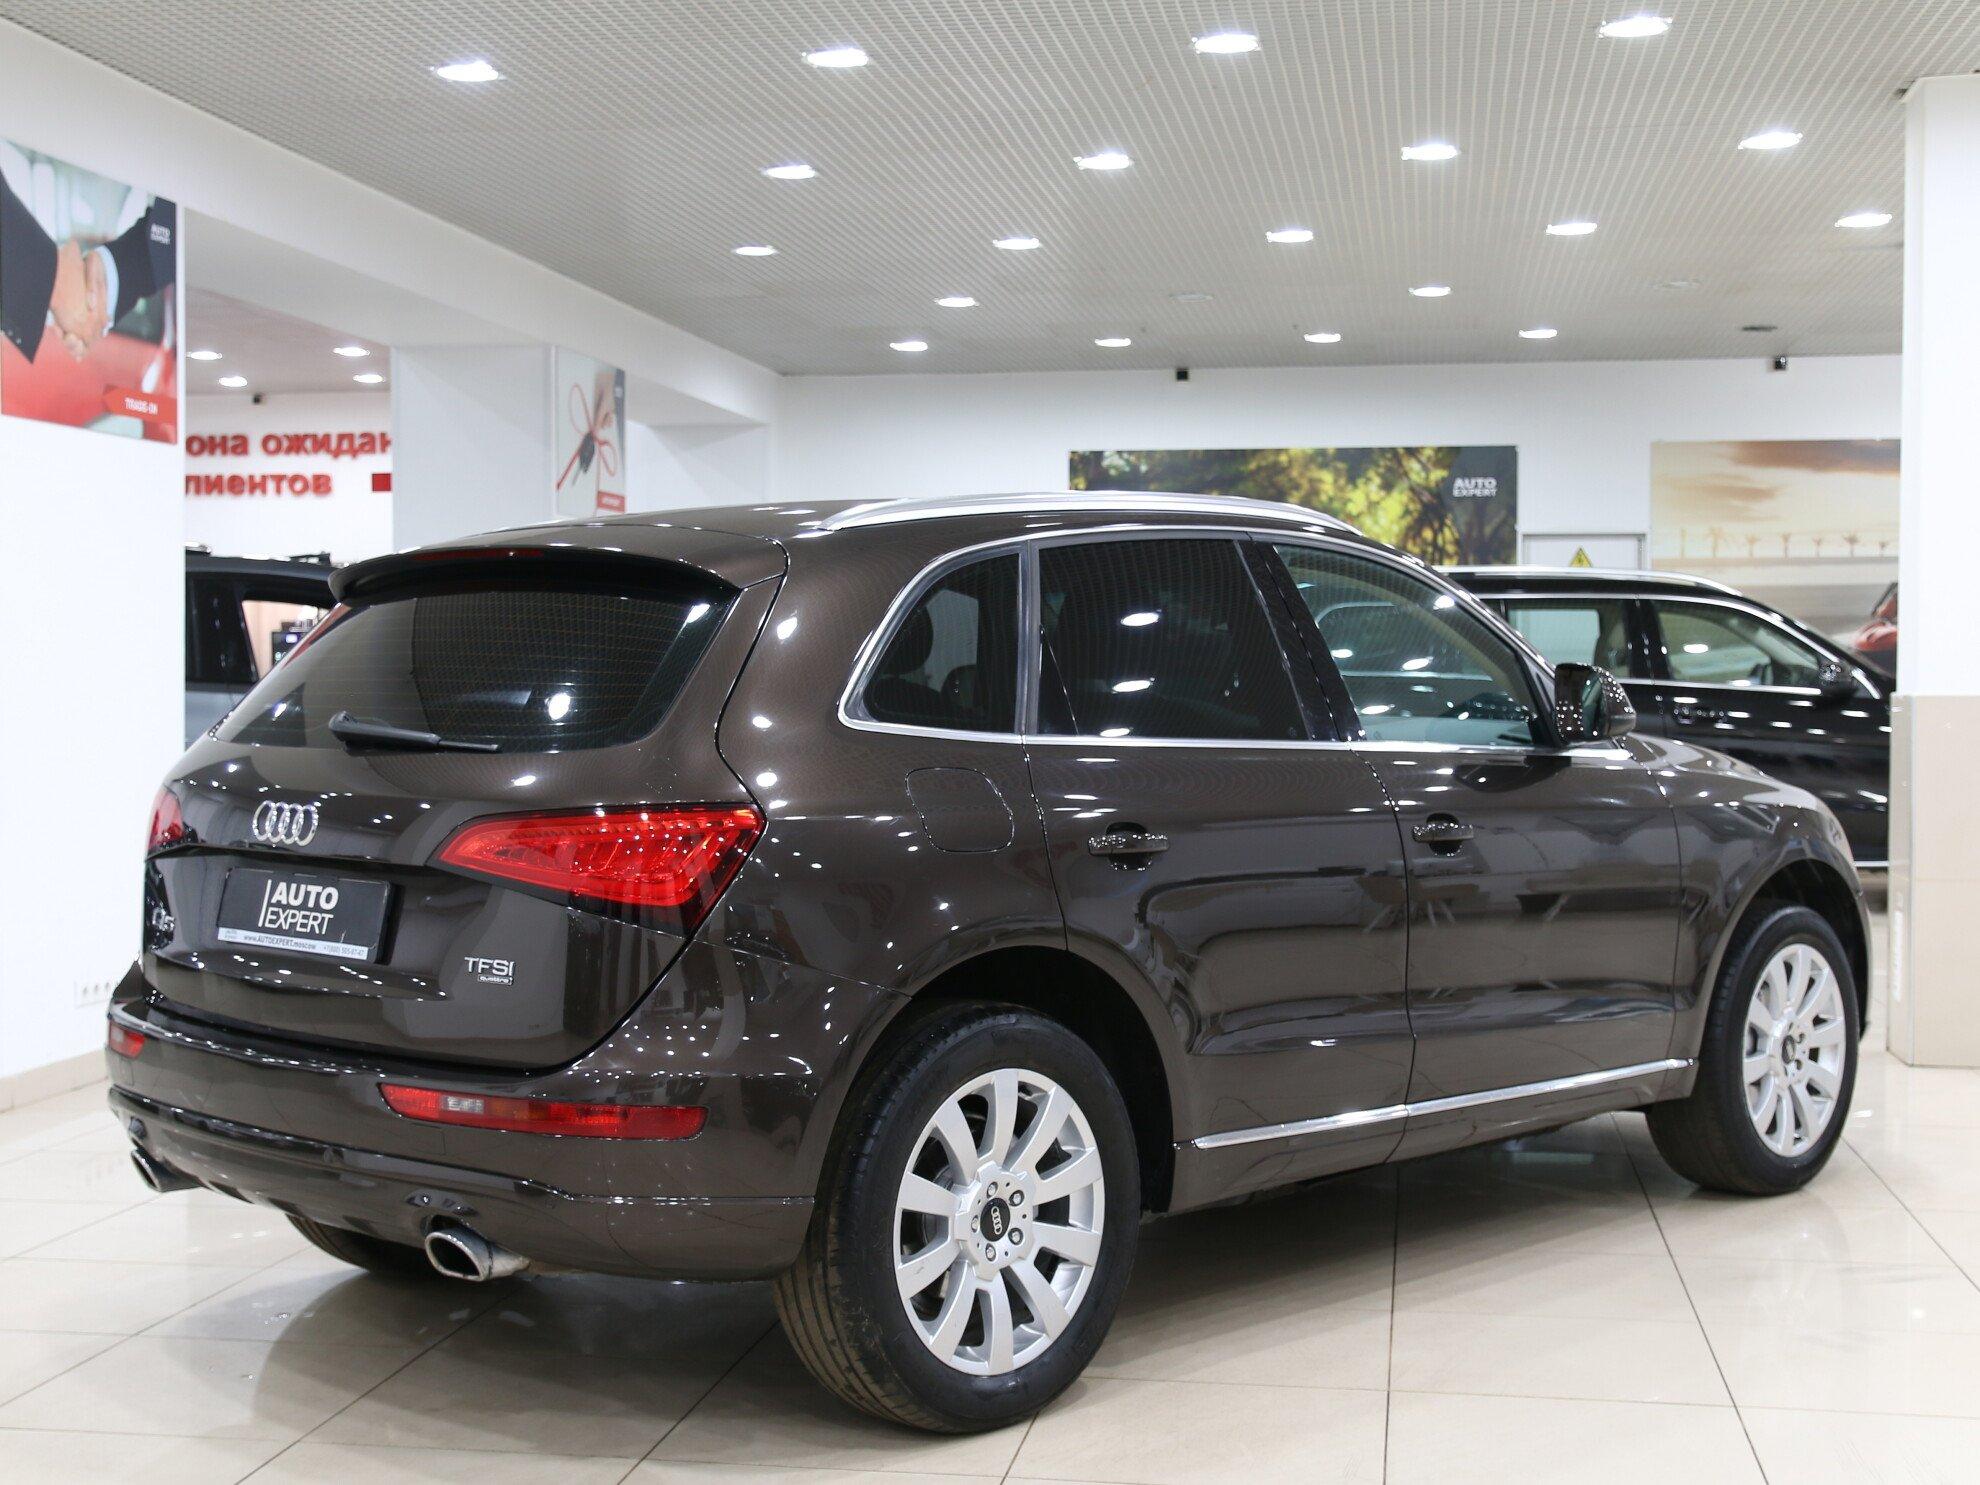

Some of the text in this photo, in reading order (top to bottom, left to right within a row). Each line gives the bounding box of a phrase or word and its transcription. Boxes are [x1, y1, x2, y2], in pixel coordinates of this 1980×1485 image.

[1454, 477, 1497, 489] AUTO
[1453, 489, 1497, 498] EXPERT
[270, 882, 339, 910] AUTO
[265, 908, 334, 935] EXPERT
[464, 956, 515, 976] TFSI
